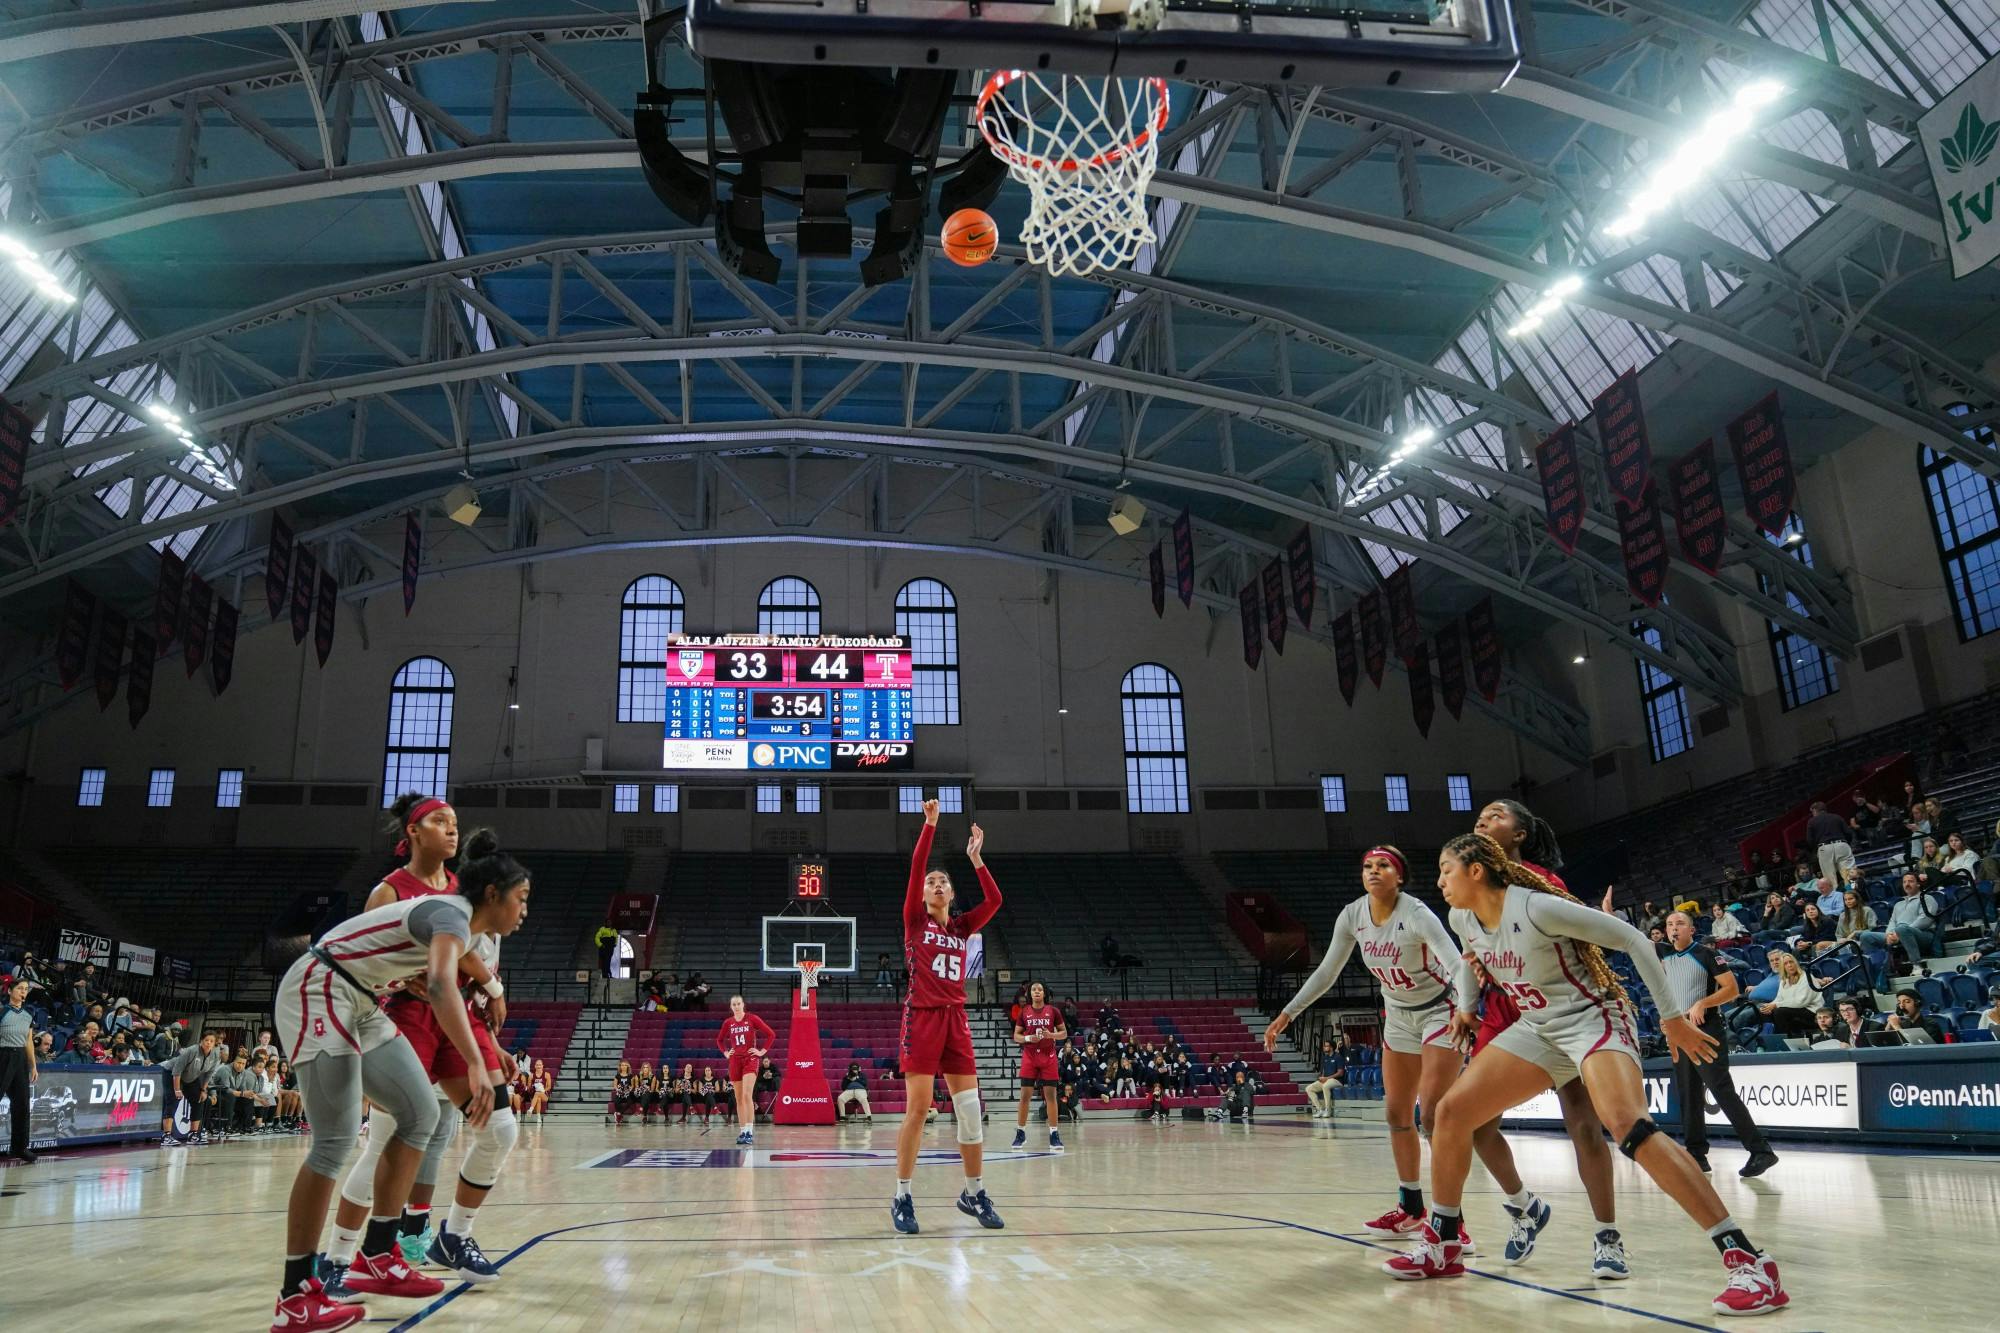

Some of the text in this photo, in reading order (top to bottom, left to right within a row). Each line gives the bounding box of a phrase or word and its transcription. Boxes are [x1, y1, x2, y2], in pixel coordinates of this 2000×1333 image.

[1947, 176, 2000, 242] IV
[676, 636, 903, 647] ALAN AUFZIEN FAMILY VIDEOBOARD
[730, 652, 767, 679] 33
[811, 653, 849, 679] 44
[771, 695, 822, 716] 3:54
[902, 701, 910, 709] 11
[802, 723, 810, 735] 3
[777, 747, 826, 764] PNC
[837, 743, 907, 756] DAVID
[857, 753, 890, 767] Auto
[802, 865, 822, 875] 3:54
[798, 877, 820, 895] 30
[61, 931, 110, 952] DAVID
[922, 931, 965, 951] PENN
[1364, 941, 1402, 965] Philly
[932, 953, 961, 981] 45
[1483, 951, 1525, 976] Philly
[731, 1026, 749, 1034] PENN
[735, 1034, 746, 1045] 14
[90, 1079, 154, 1104] DAVID
[106, 1095, 138, 1130] Auto
